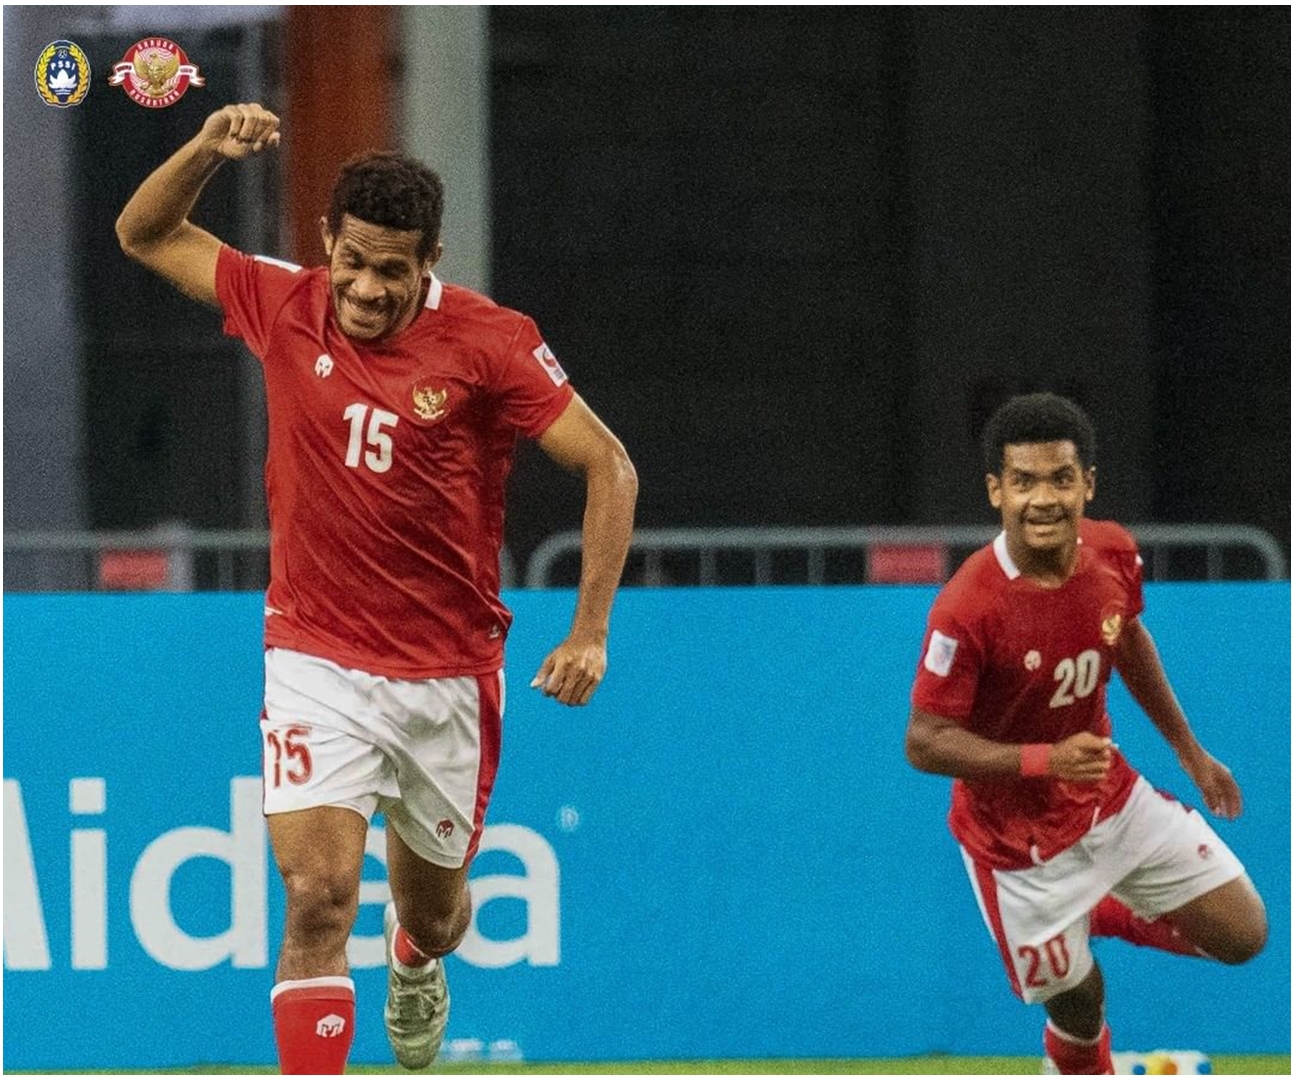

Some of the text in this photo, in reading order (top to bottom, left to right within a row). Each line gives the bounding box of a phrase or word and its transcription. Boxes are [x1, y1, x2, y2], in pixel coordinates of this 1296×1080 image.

[343, 403, 399, 474] 15
[1049, 650, 1101, 708] 20
[267, 723, 312, 788] 15
[1017, 934, 1070, 988] 20
